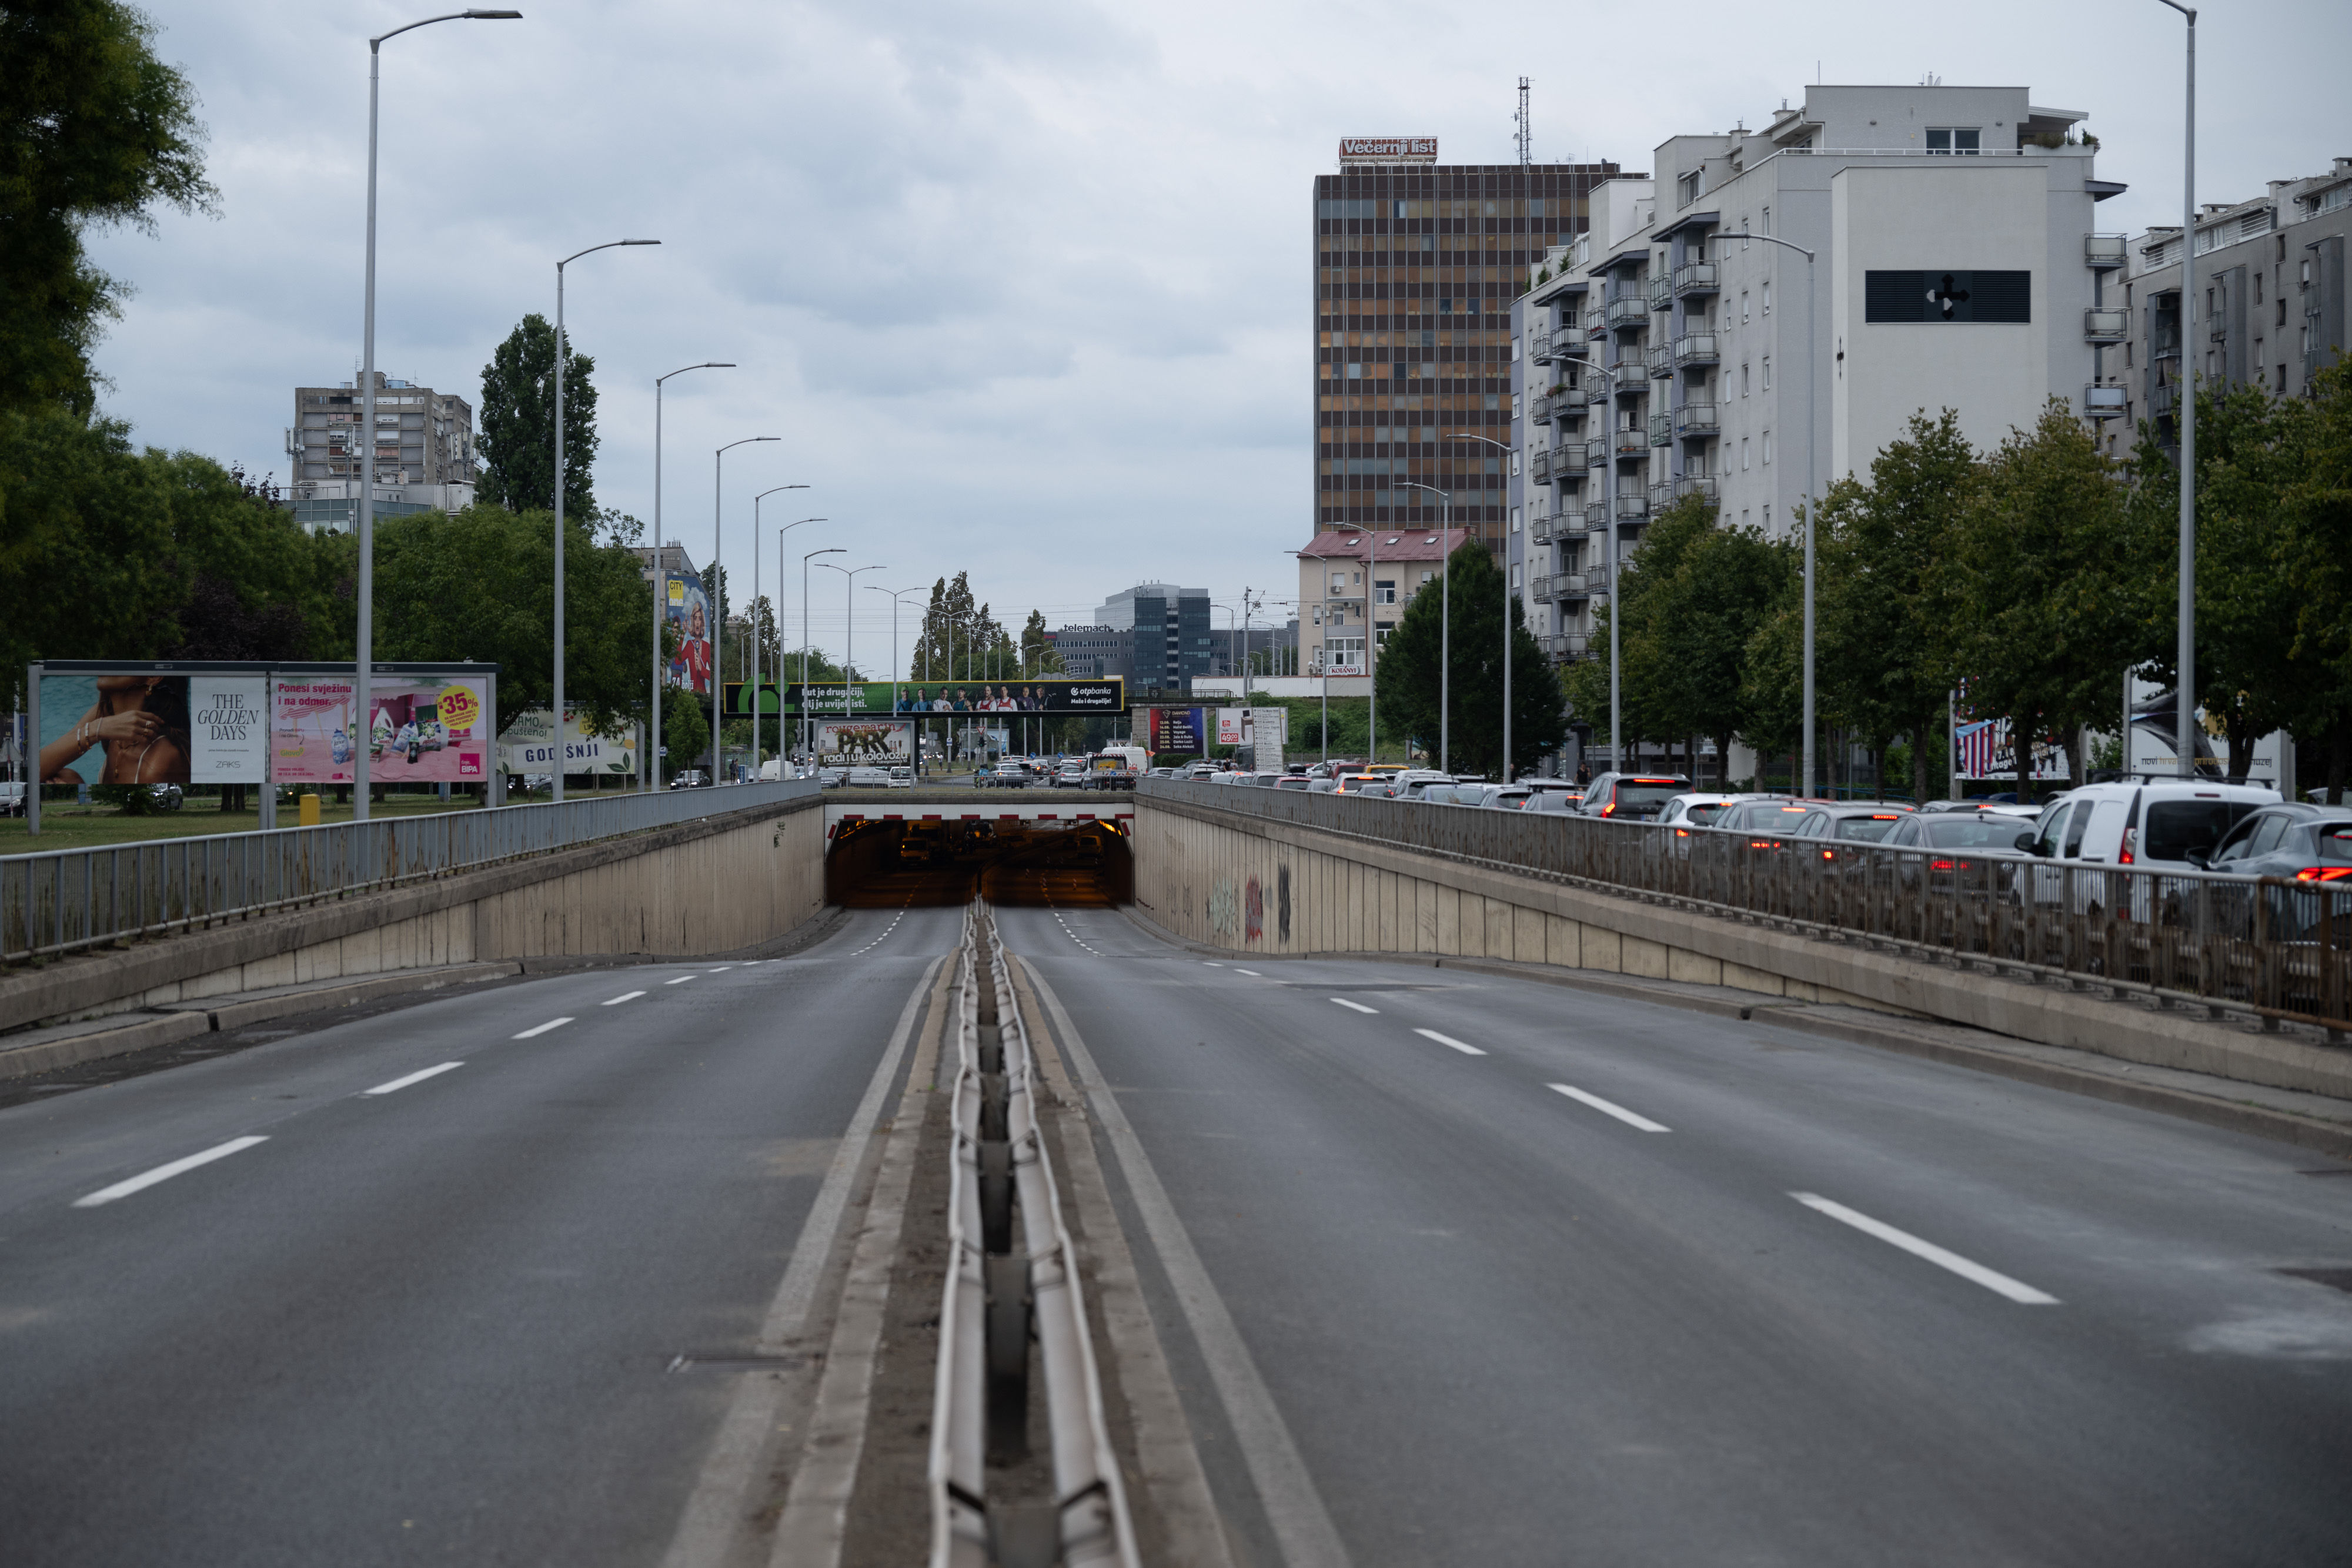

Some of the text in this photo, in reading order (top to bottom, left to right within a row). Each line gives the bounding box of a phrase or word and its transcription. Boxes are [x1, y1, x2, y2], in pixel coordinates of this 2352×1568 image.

[1344, 139, 1435, 156] Večernji list
[670, 581, 682, 590] CITY
[669, 598, 683, 606] one
[278, 684, 351, 694] Ponesi svježinu
[681, 680, 694, 692] bolji
[816, 687, 825, 698] je
[212, 694, 243, 709] THE
[278, 696, 280, 705] i
[299, 697, 331, 706] odmor.
[815, 699, 823, 710] je
[851, 699, 867, 707] isti.
[198, 710, 259, 724] GOLDEN
[211, 726, 246, 740] DAYS
[826, 723, 898, 736] rougemarin
[837, 727, 891, 755] PARK
[525, 743, 599, 763] GODŠNJI
[2050, 744, 2063, 755] Bar
[823, 752, 844, 763] radi
[847, 753, 849, 761] i
[859, 750, 908, 761] kolovozu
[2141, 756, 2157, 765] novi
